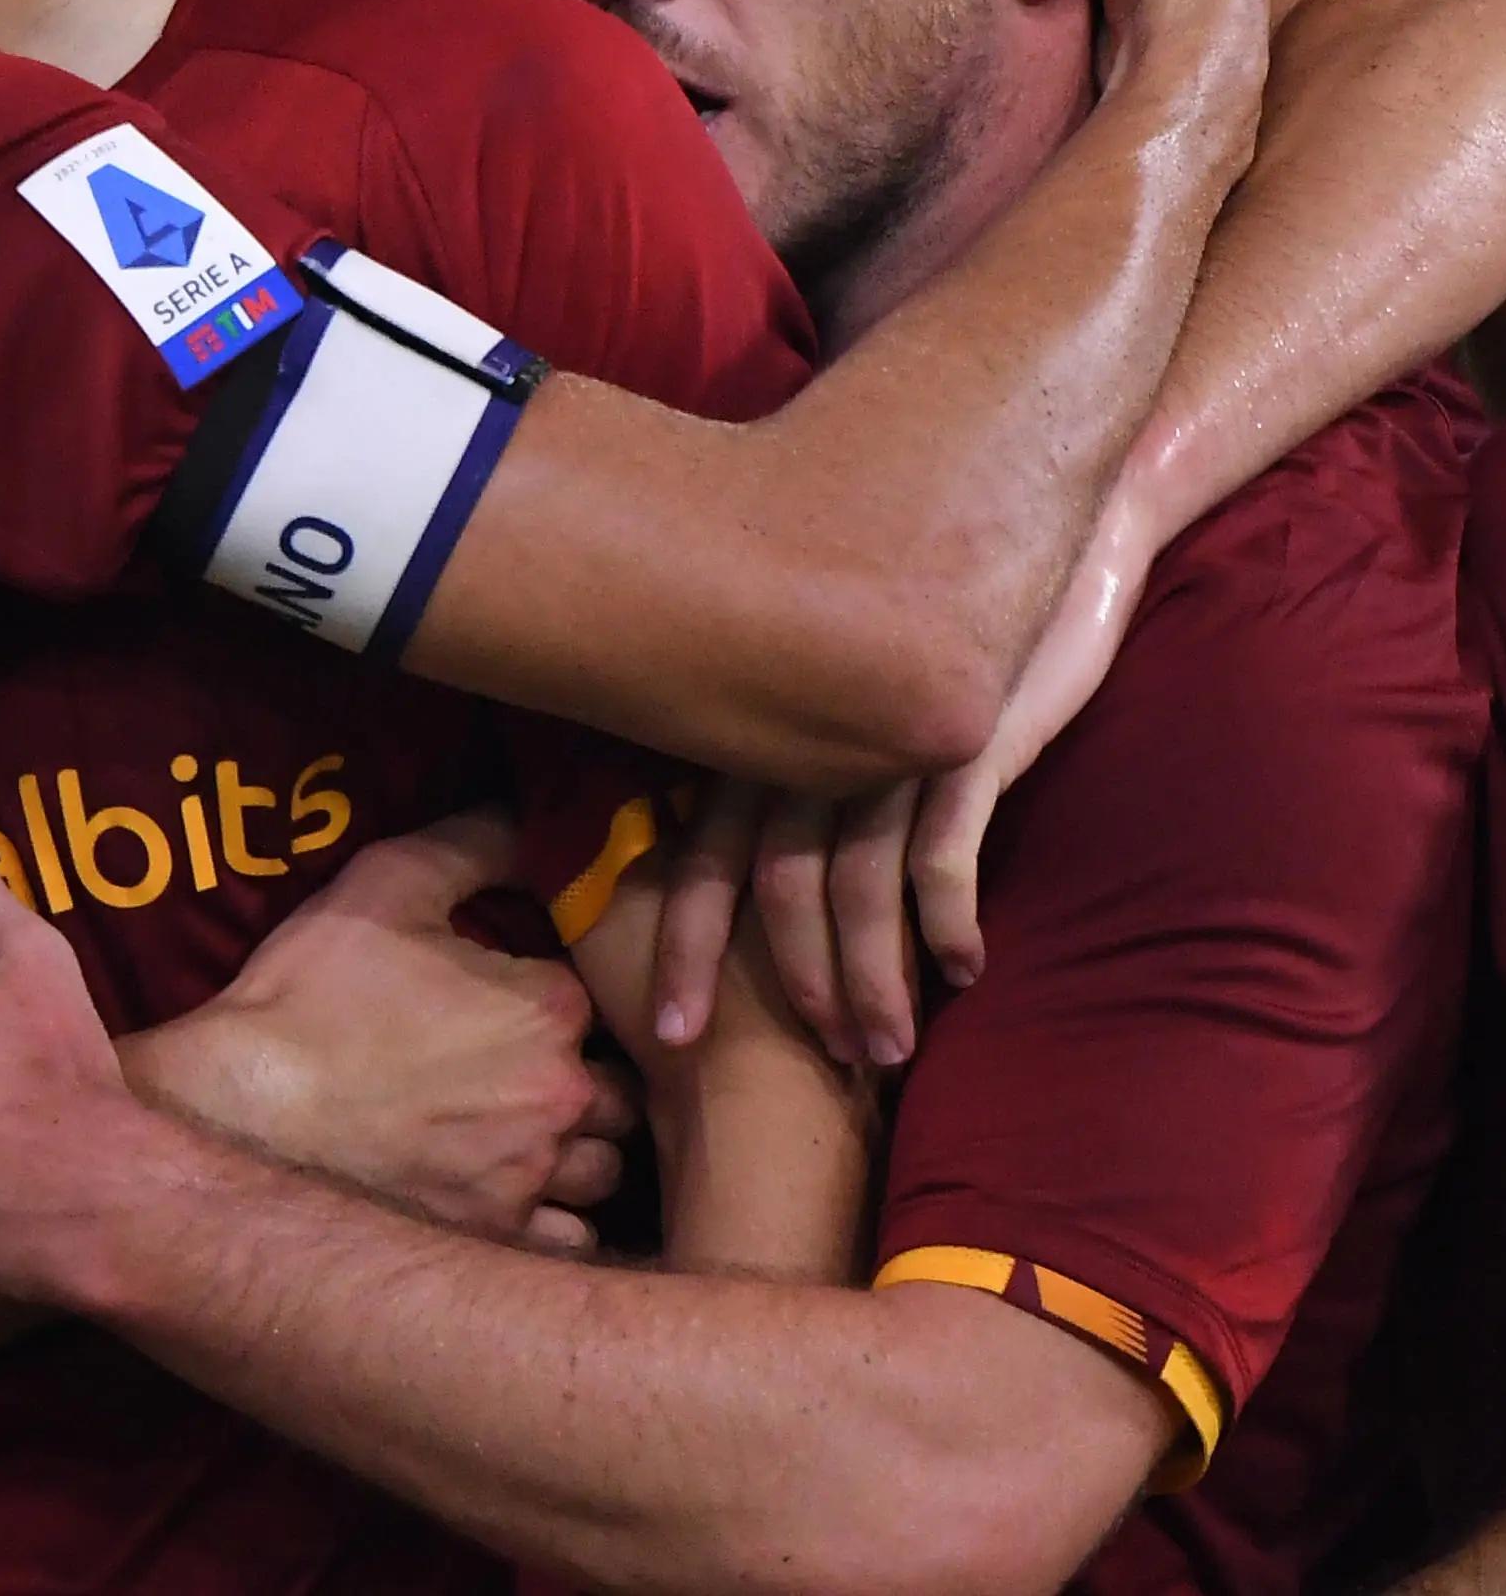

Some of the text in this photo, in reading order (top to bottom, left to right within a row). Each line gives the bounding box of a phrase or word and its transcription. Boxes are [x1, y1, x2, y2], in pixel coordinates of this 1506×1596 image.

[153, 252, 252, 325] SERIE A
[216, 286, 278, 340] TIM
